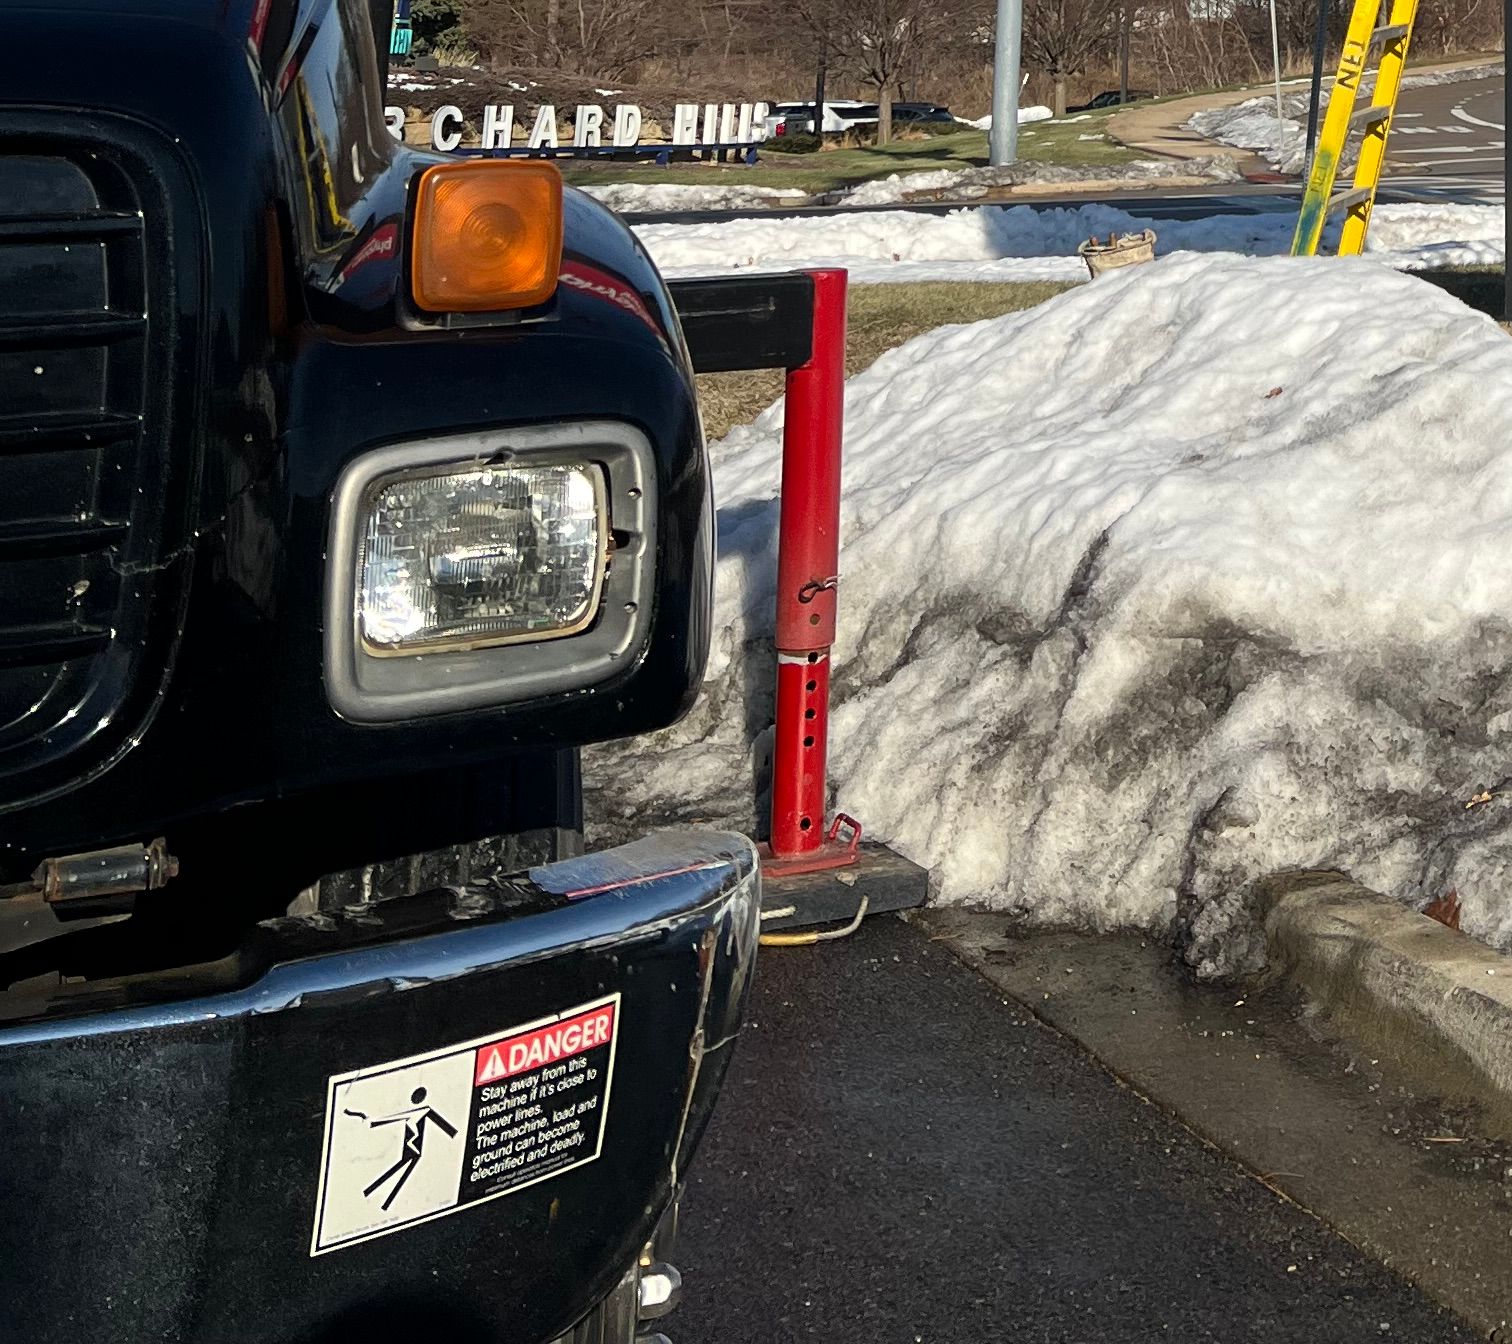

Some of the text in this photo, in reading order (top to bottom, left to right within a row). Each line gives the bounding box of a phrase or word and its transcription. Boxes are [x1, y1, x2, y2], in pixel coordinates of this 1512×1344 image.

[508, 1015, 609, 1072] DANGER
[479, 1094, 527, 1118] machine
[557, 1073, 585, 1092] close
[587, 1069, 598, 1081] to
[481, 1057, 587, 1101] Stay away from this
[472, 1141, 513, 1169] ground
[515, 1136, 536, 1152] can
[538, 1119, 580, 1143] become
[476, 1105, 543, 1137] power lines.
[476, 1134, 498, 1149] The
[552, 1104, 576, 1123] load
[577, 1095, 598, 1114] and
[470, 1152, 525, 1182] electrified
[527, 1144, 548, 1162] and
